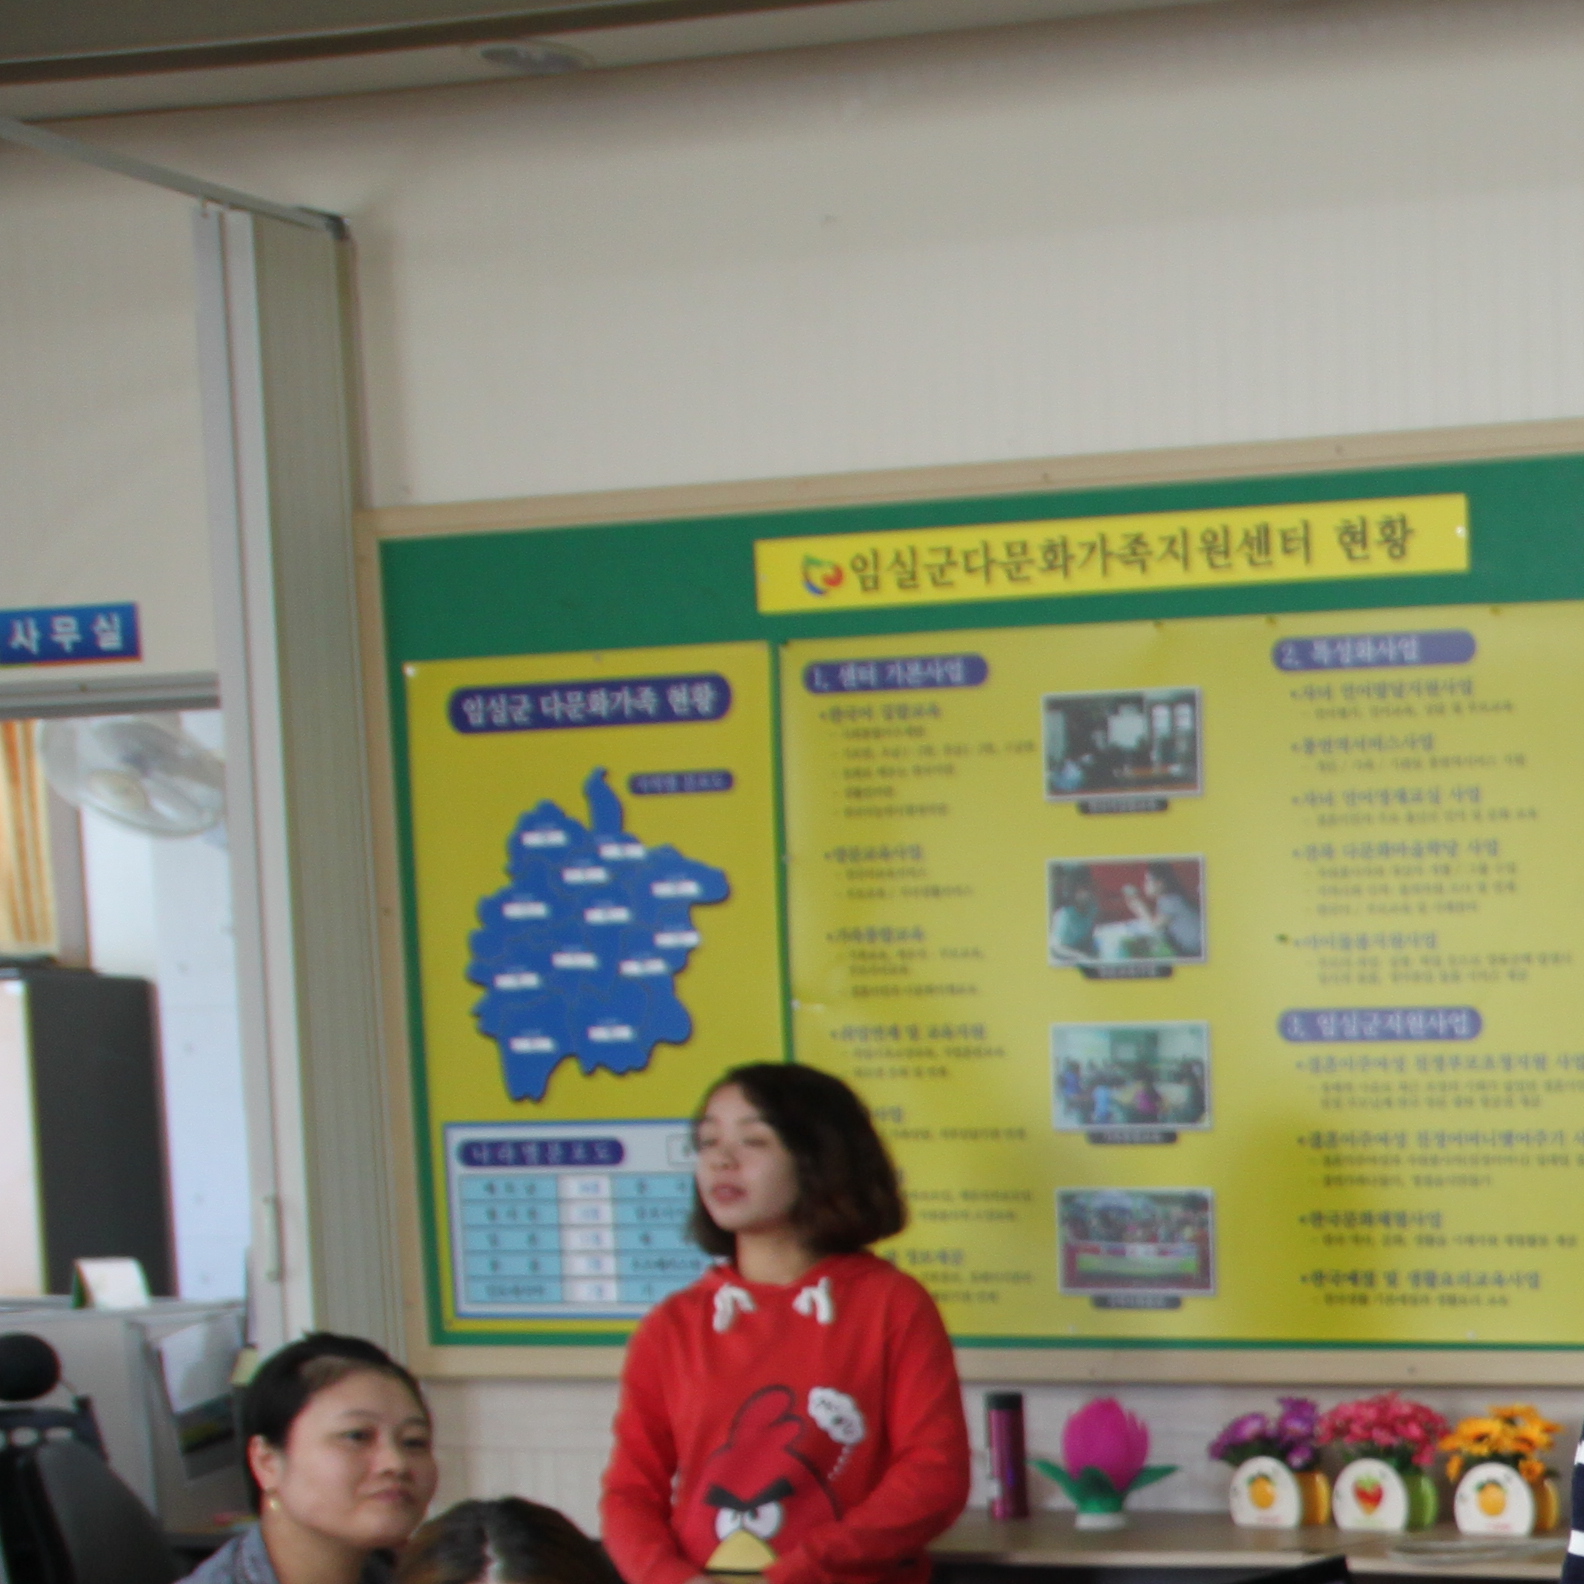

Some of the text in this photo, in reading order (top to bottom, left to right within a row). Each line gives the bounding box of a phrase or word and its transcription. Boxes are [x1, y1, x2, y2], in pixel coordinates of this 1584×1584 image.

[849, 513, 1416, 592] 임실군다문화가족지원센터 현황
[9, 612, 123, 655] 사무실
[1310, 634, 1421, 665] 특성화사업
[462, 679, 717, 728] 임실군 다문화가족 현황
